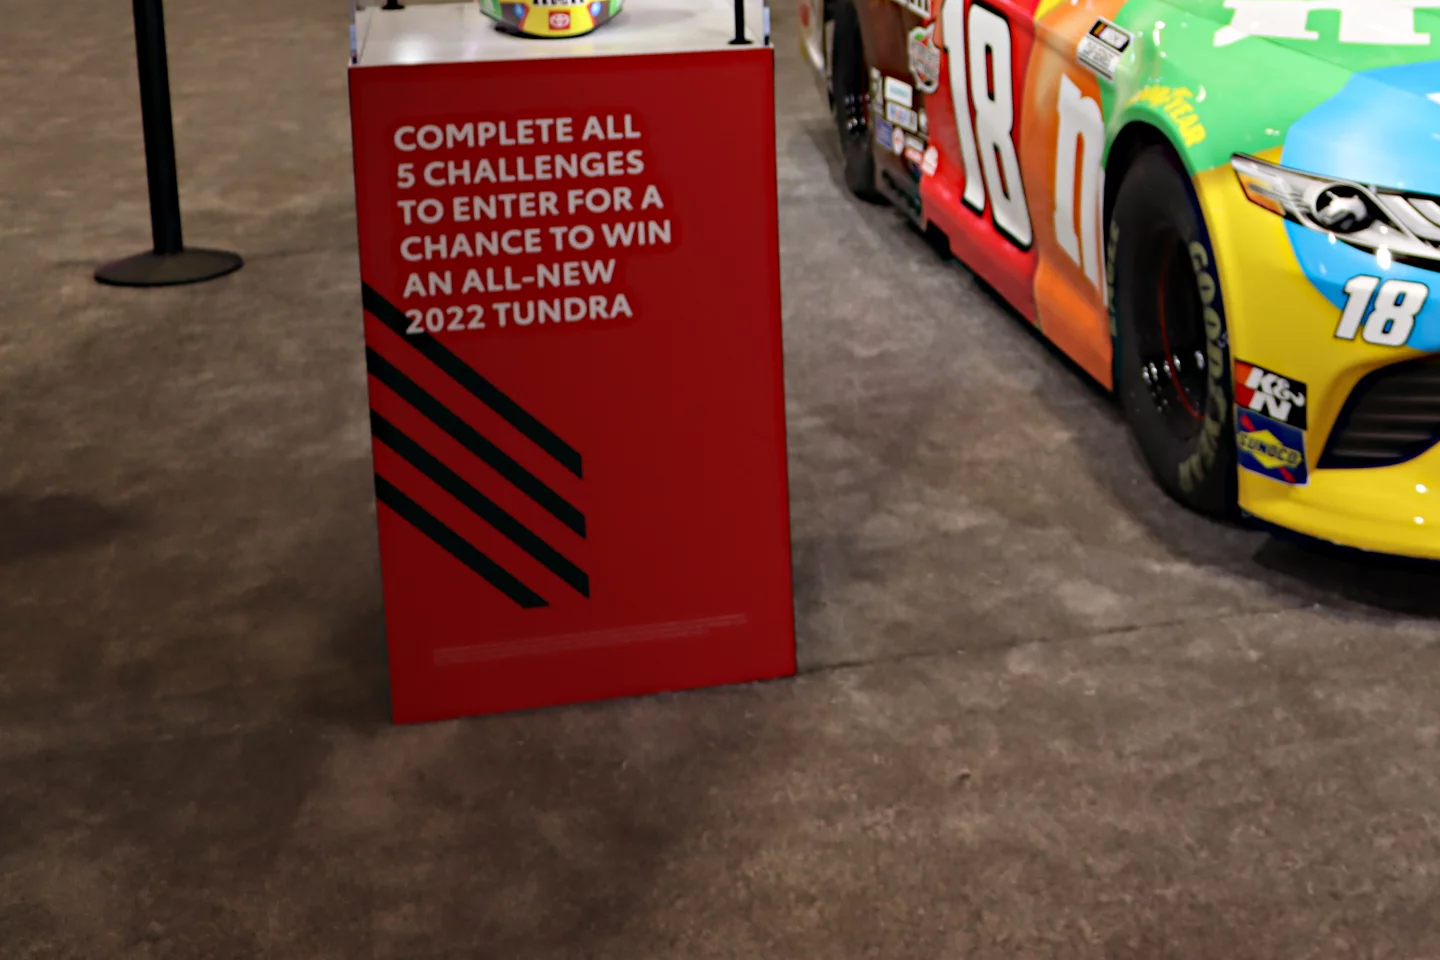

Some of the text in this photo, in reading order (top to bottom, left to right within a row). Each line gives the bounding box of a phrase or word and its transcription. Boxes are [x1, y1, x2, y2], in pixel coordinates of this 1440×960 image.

[394, 113, 642, 152] COMPLETE ALL
[396, 149, 645, 189] 5 CHALLENGES
[397, 184, 664, 225] TO ENTER FOR A
[400, 219, 672, 262] CHANCE TO WIN
[402, 258, 616, 299] AN ALL-NEW
[404, 293, 634, 335] 2022 TUNDRA
[1333, 273, 1430, 347] 18
[1244, 366, 1306, 422] K&N
[1237, 431, 1301, 463] SUNOCO
